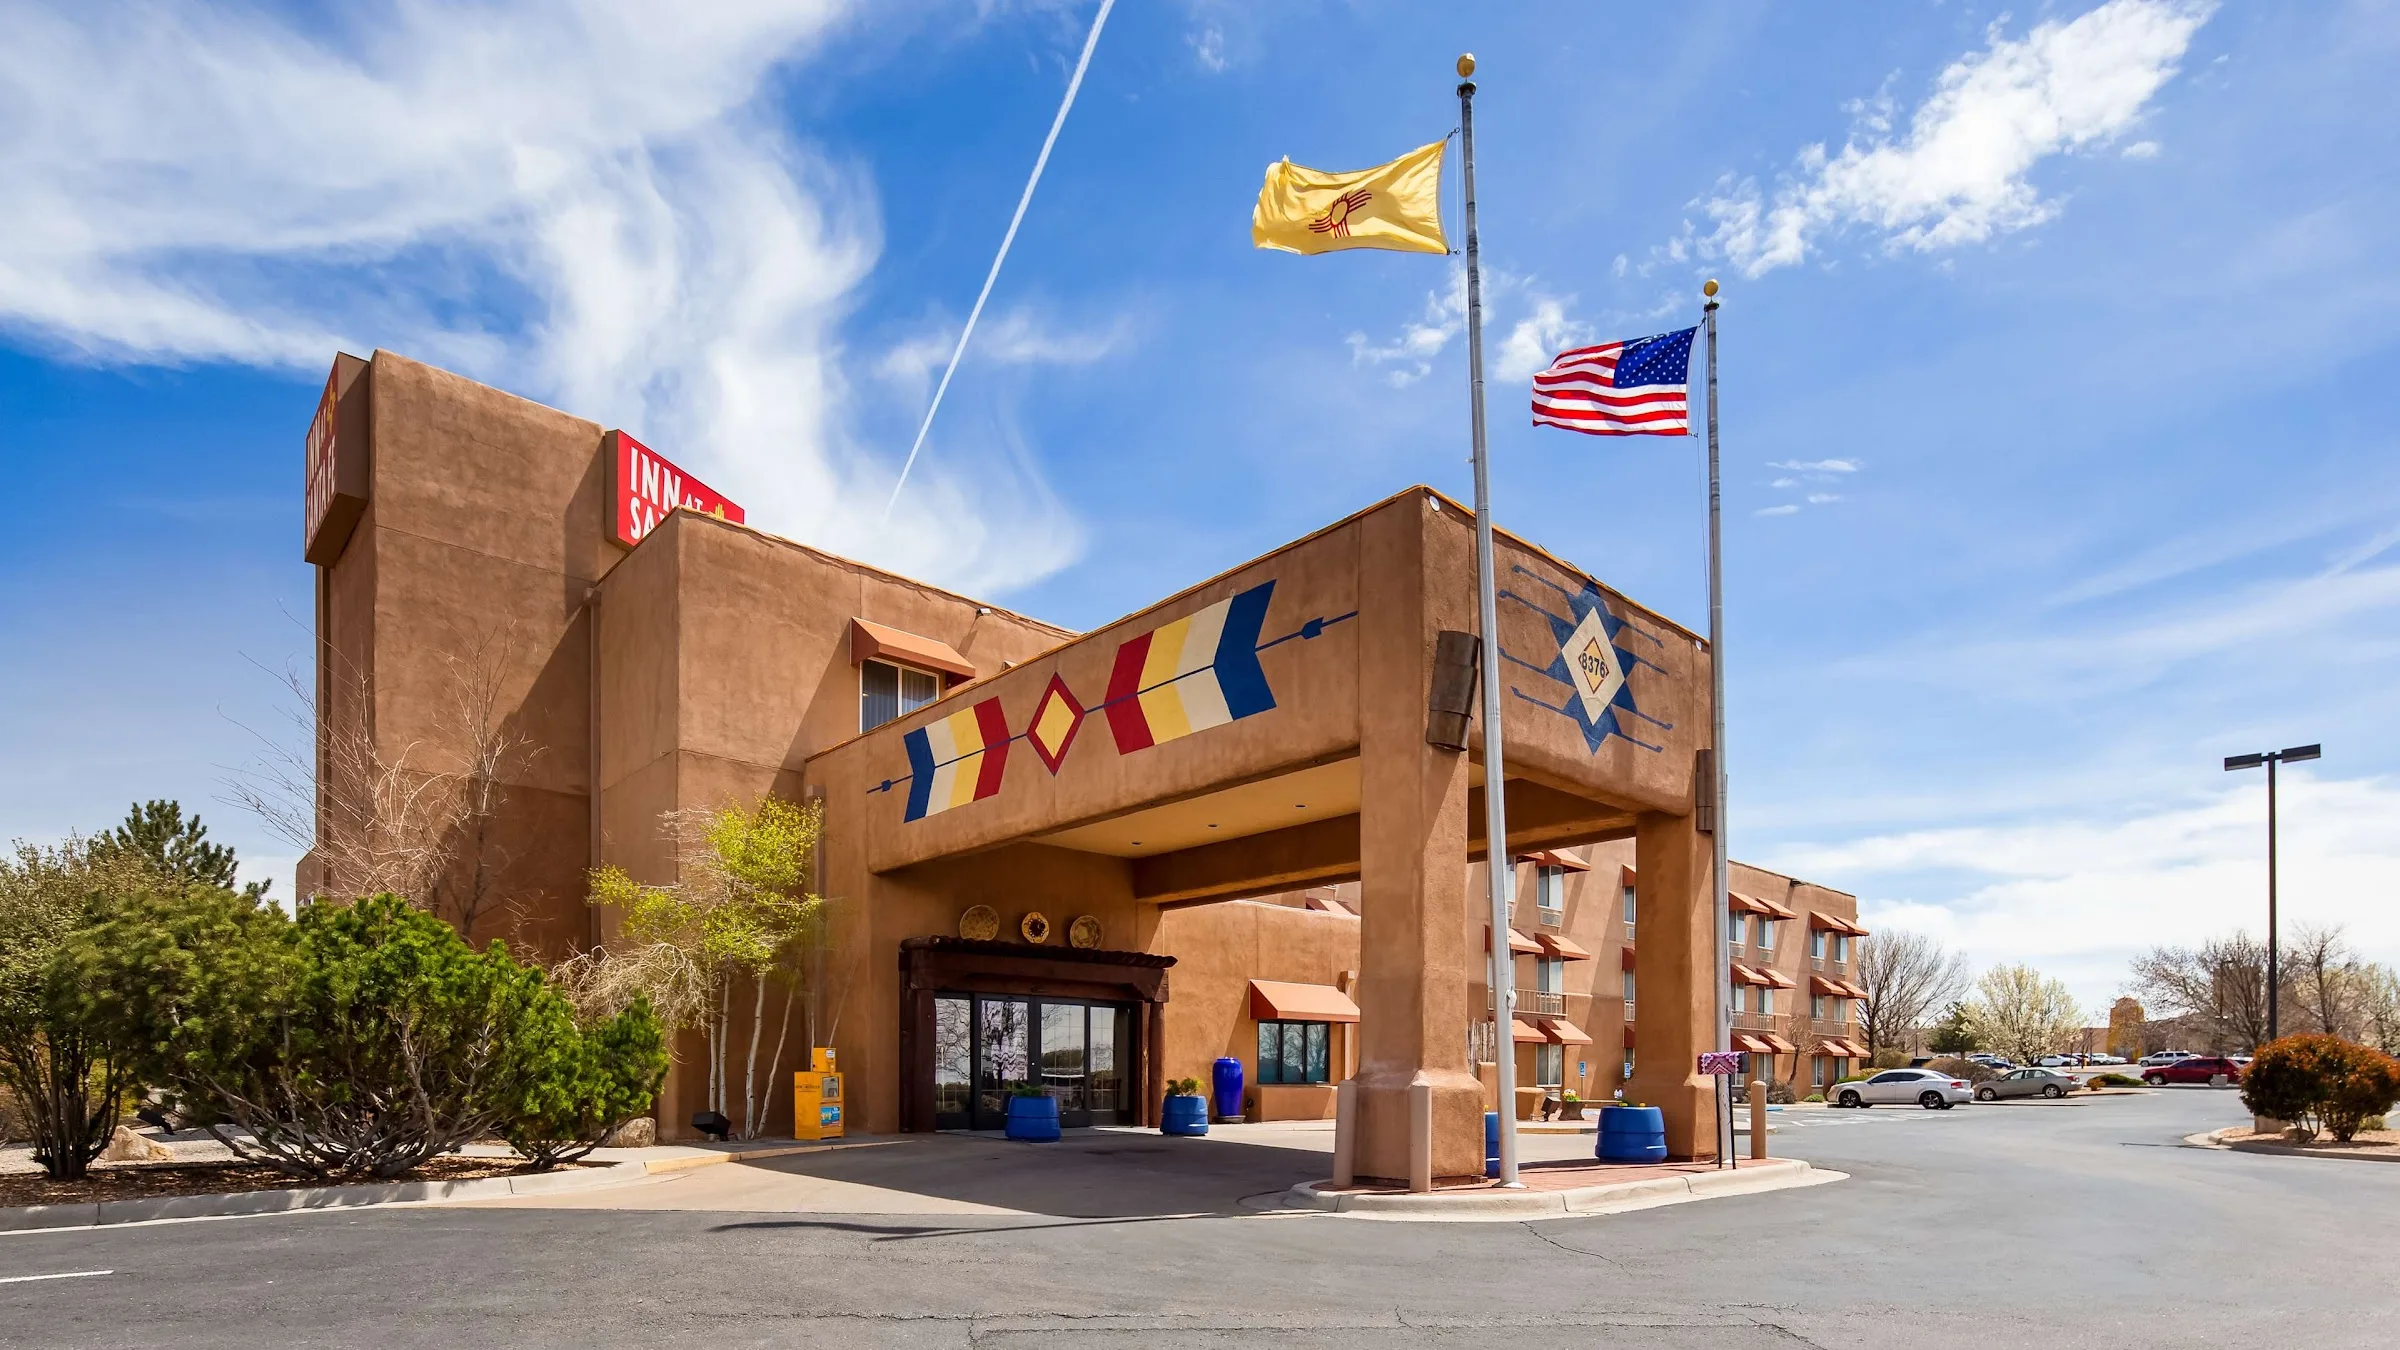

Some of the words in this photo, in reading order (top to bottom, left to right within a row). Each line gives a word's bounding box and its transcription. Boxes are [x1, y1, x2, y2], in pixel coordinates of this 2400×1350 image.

[307, 410, 321, 492] INN
[630, 446, 681, 513] INN
[306, 459, 327, 550] SANTA
[327, 435, 336, 503] FE
[630, 496, 665, 540] SA
[1581, 652, 1606, 679] 8376
